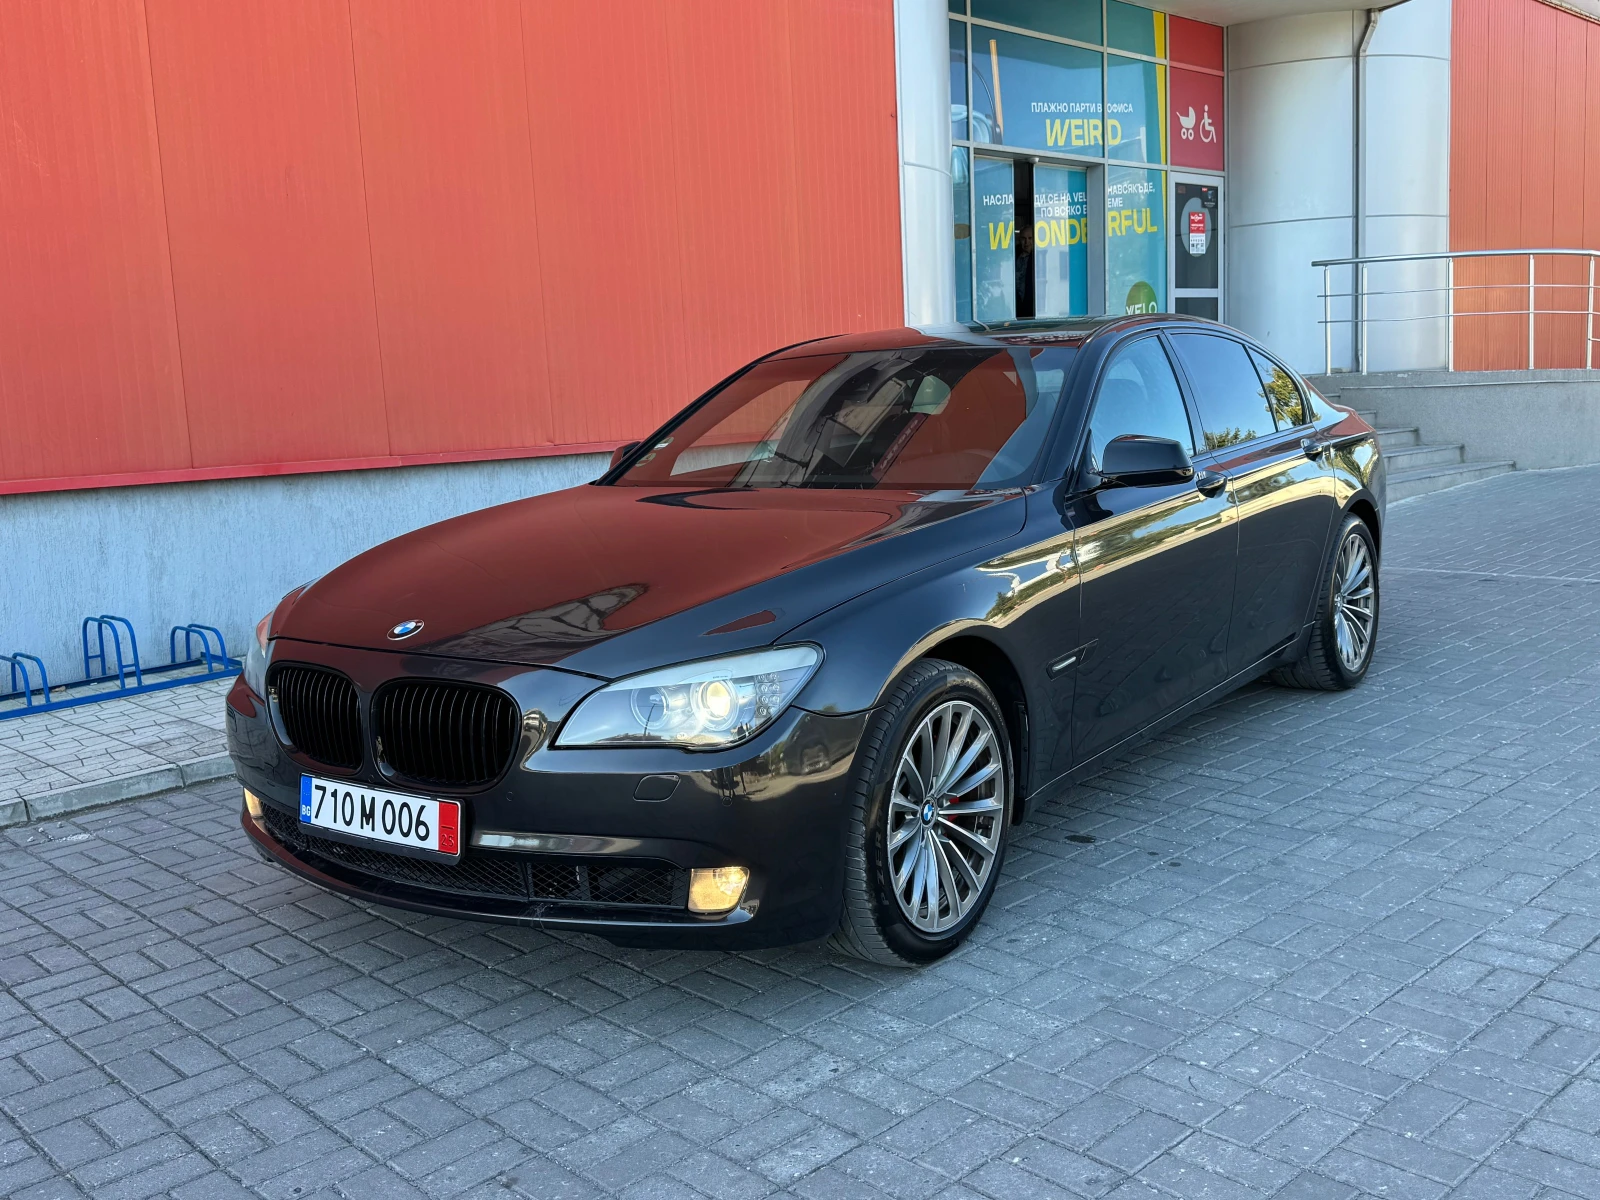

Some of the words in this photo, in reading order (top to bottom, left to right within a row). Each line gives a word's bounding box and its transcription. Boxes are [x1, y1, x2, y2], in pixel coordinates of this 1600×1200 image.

[1031, 102, 1068, 113] ПЛАЖНО
[1070, 103, 1096, 113] ПАРТИ
[1097, 103, 1103, 113] В
[1107, 103, 1133, 113] ОФИСА
[1045, 119, 1122, 147] WEIRD
[1047, 193, 1059, 204] СЕ
[1060, 192, 1072, 203] НА
[1107, 182, 1155, 195] НАВСЯКЪДЕ,
[1041, 207, 1053, 218] ПО
[1054, 205, 1081, 217] ВСЯКО
[301, 804, 311, 816] BG
